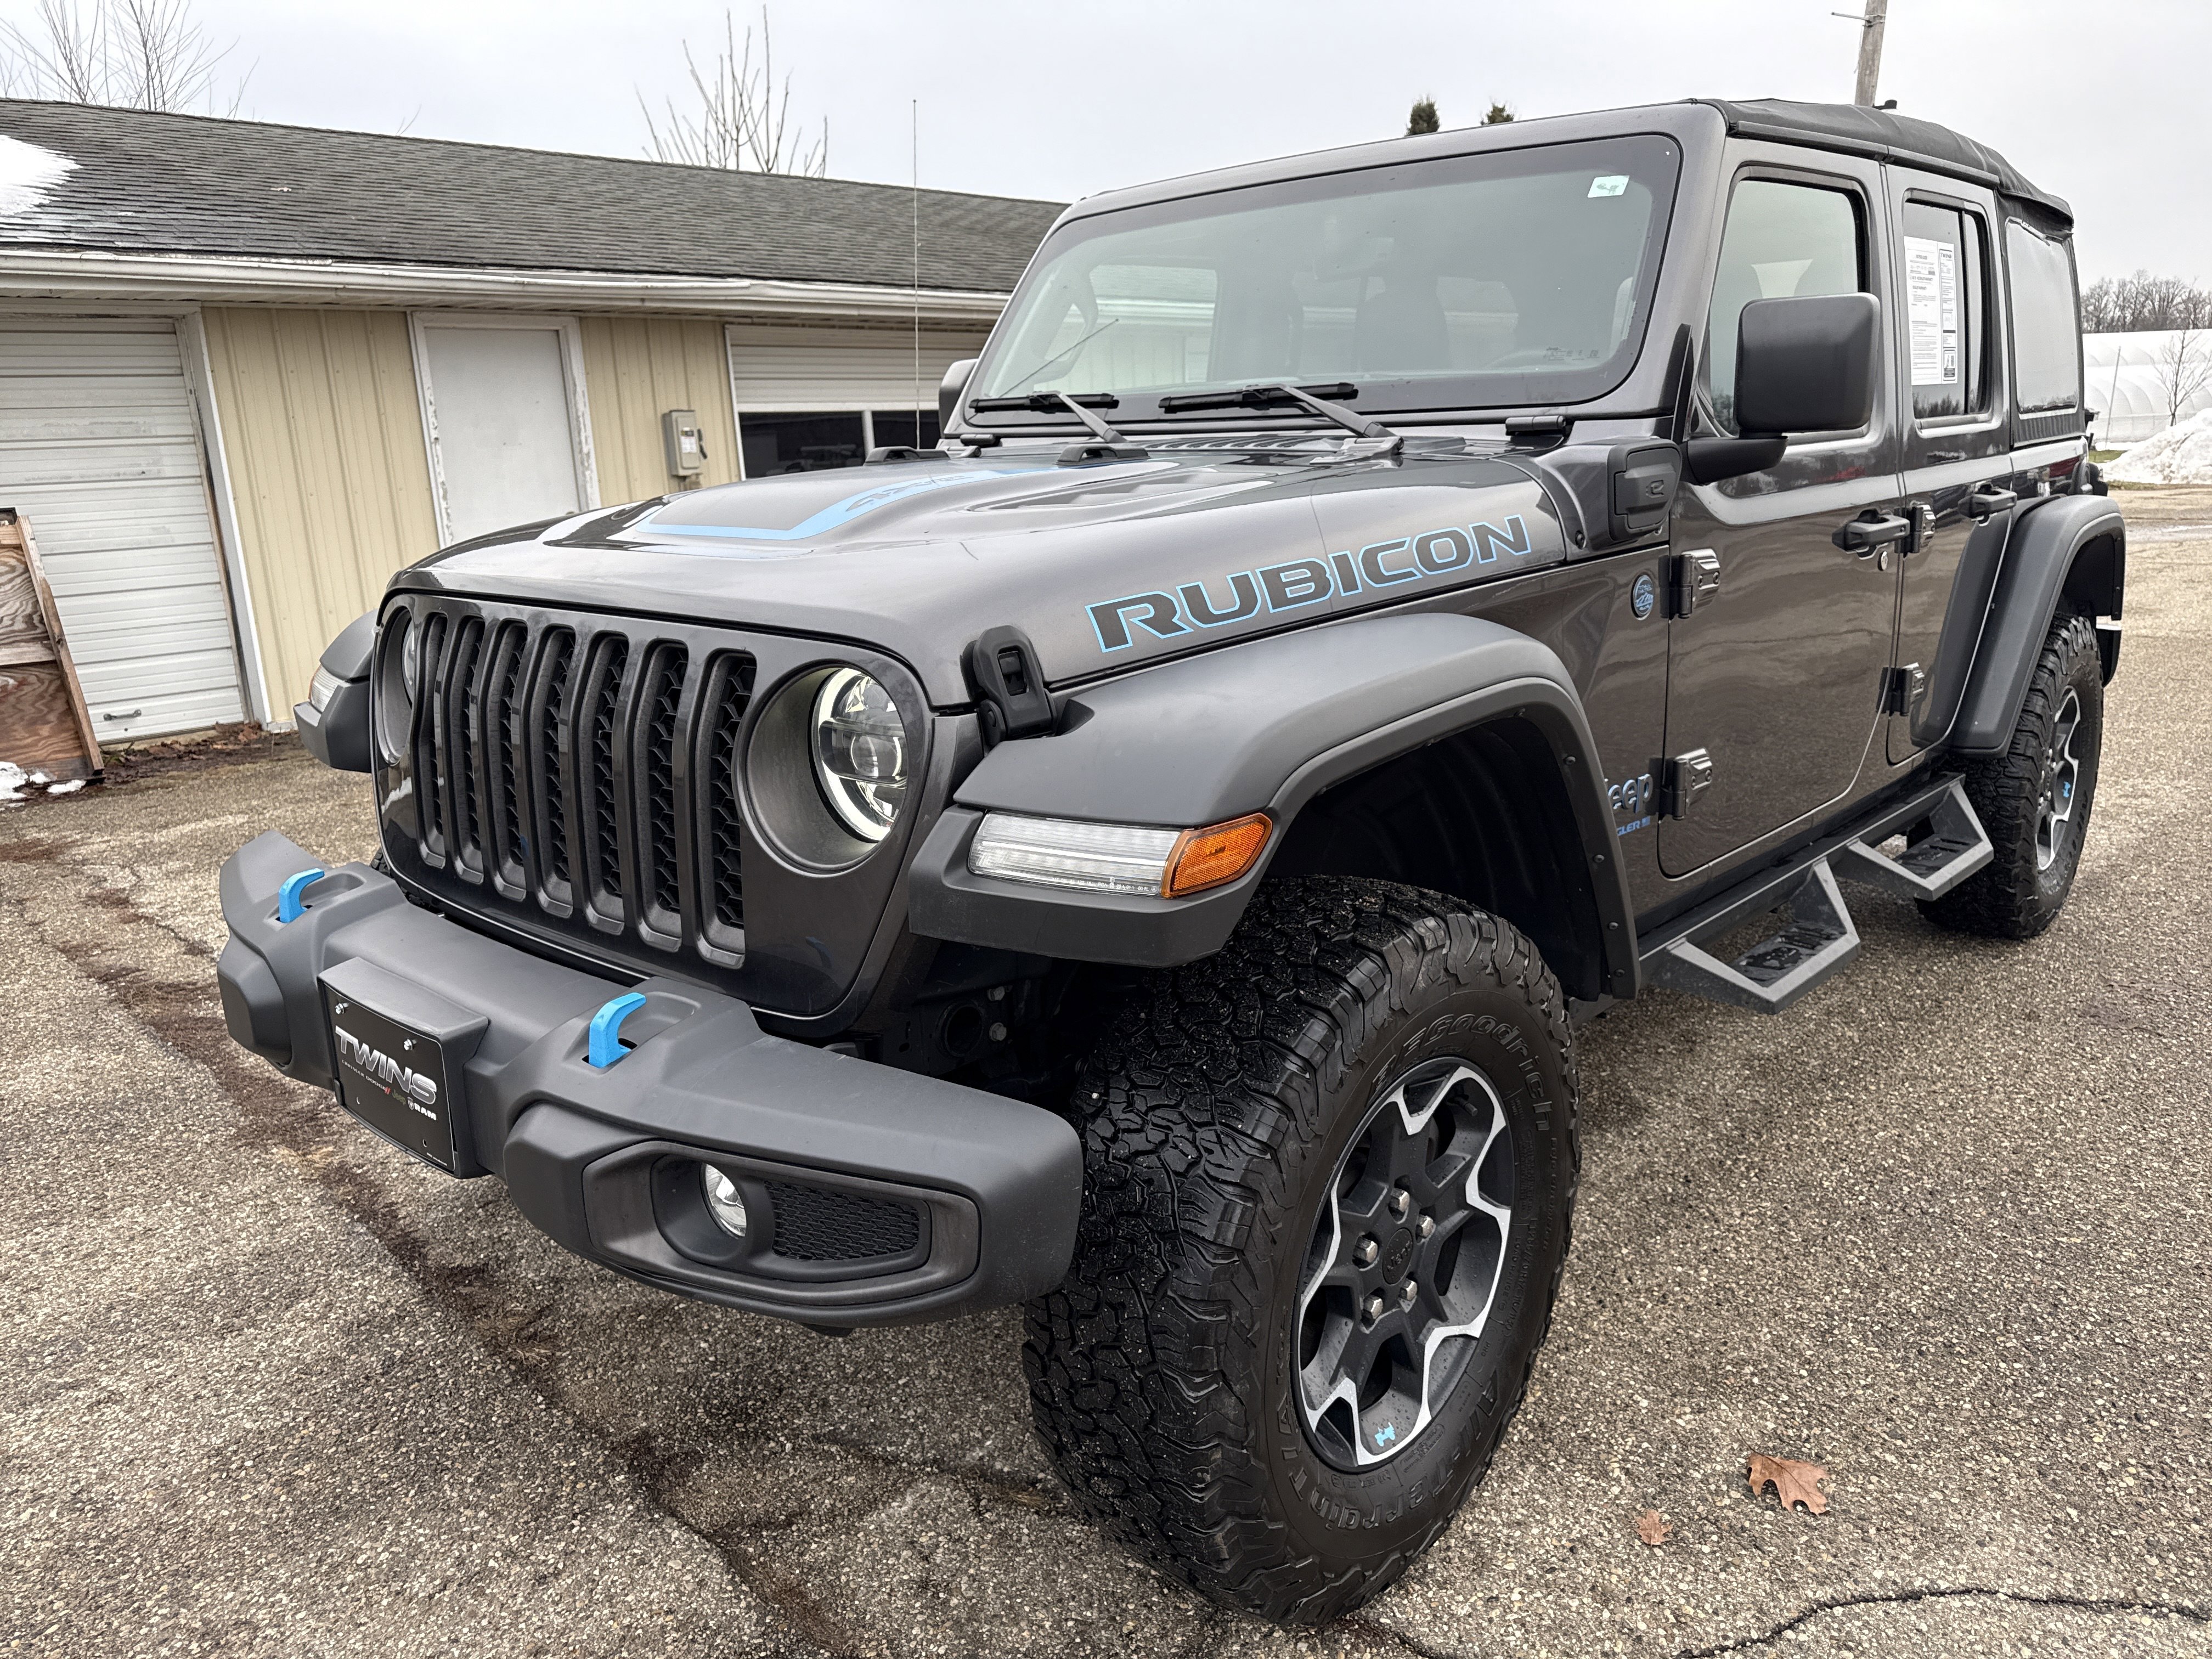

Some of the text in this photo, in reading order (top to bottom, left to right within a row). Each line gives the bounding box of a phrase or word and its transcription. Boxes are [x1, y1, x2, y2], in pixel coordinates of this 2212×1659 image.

[1085, 514, 1531, 653] RUBICON
[1605, 774, 1653, 813] eep
[1617, 820, 1641, 836] GLER
[335, 1025, 437, 1104] TWINS
[341, 1059, 437, 1121] CHRYSLER DODGE Jeep RAM
